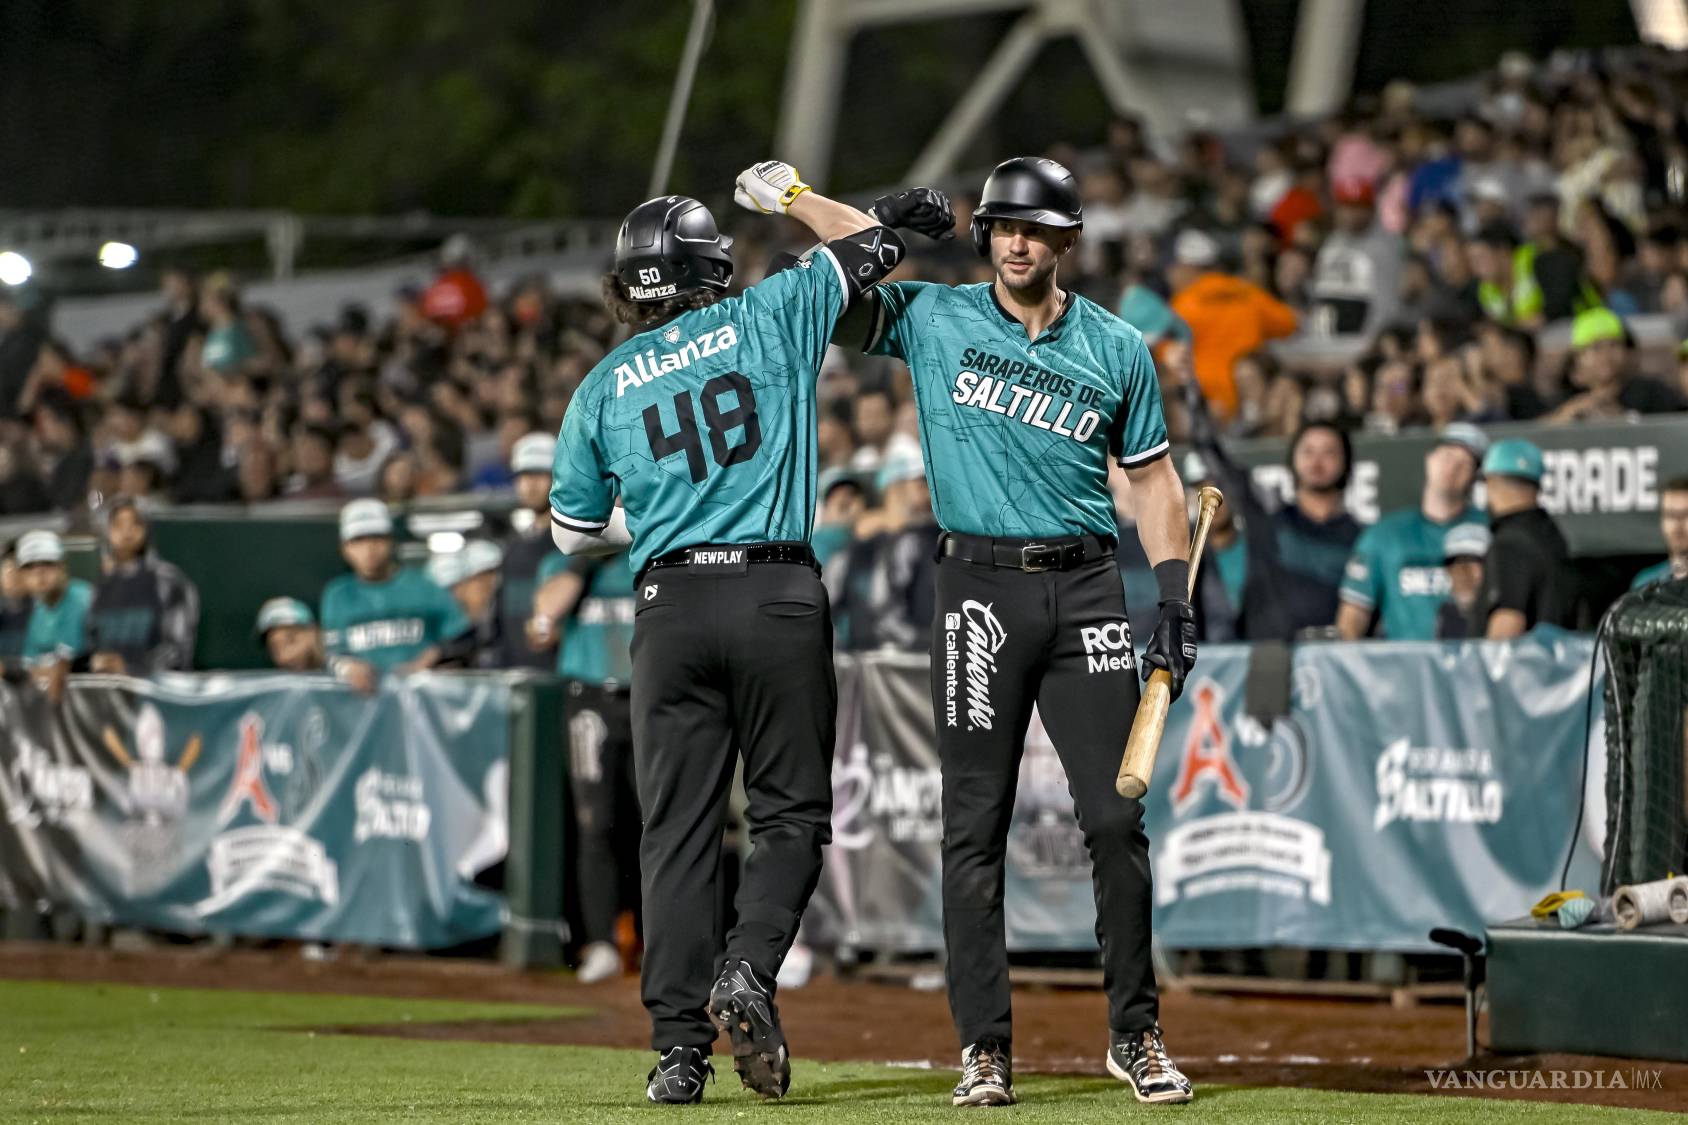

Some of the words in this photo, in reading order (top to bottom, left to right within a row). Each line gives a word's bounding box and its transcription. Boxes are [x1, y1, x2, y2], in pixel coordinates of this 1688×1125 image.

[629, 284, 677, 299] Alianza
[639, 267, 661, 285] 50
[614, 324, 738, 398] Alianza
[960, 348, 1076, 399] SARAPEROS
[1079, 385, 1106, 409] DE
[642, 371, 762, 484] 48
[952, 370, 1101, 443] SALTILLO
[694, 550, 743, 565] NEWPLAY
[962, 599, 1007, 730] Caliente
[1080, 622, 1132, 654] RCG
[946, 631, 960, 727] caliente.mx
